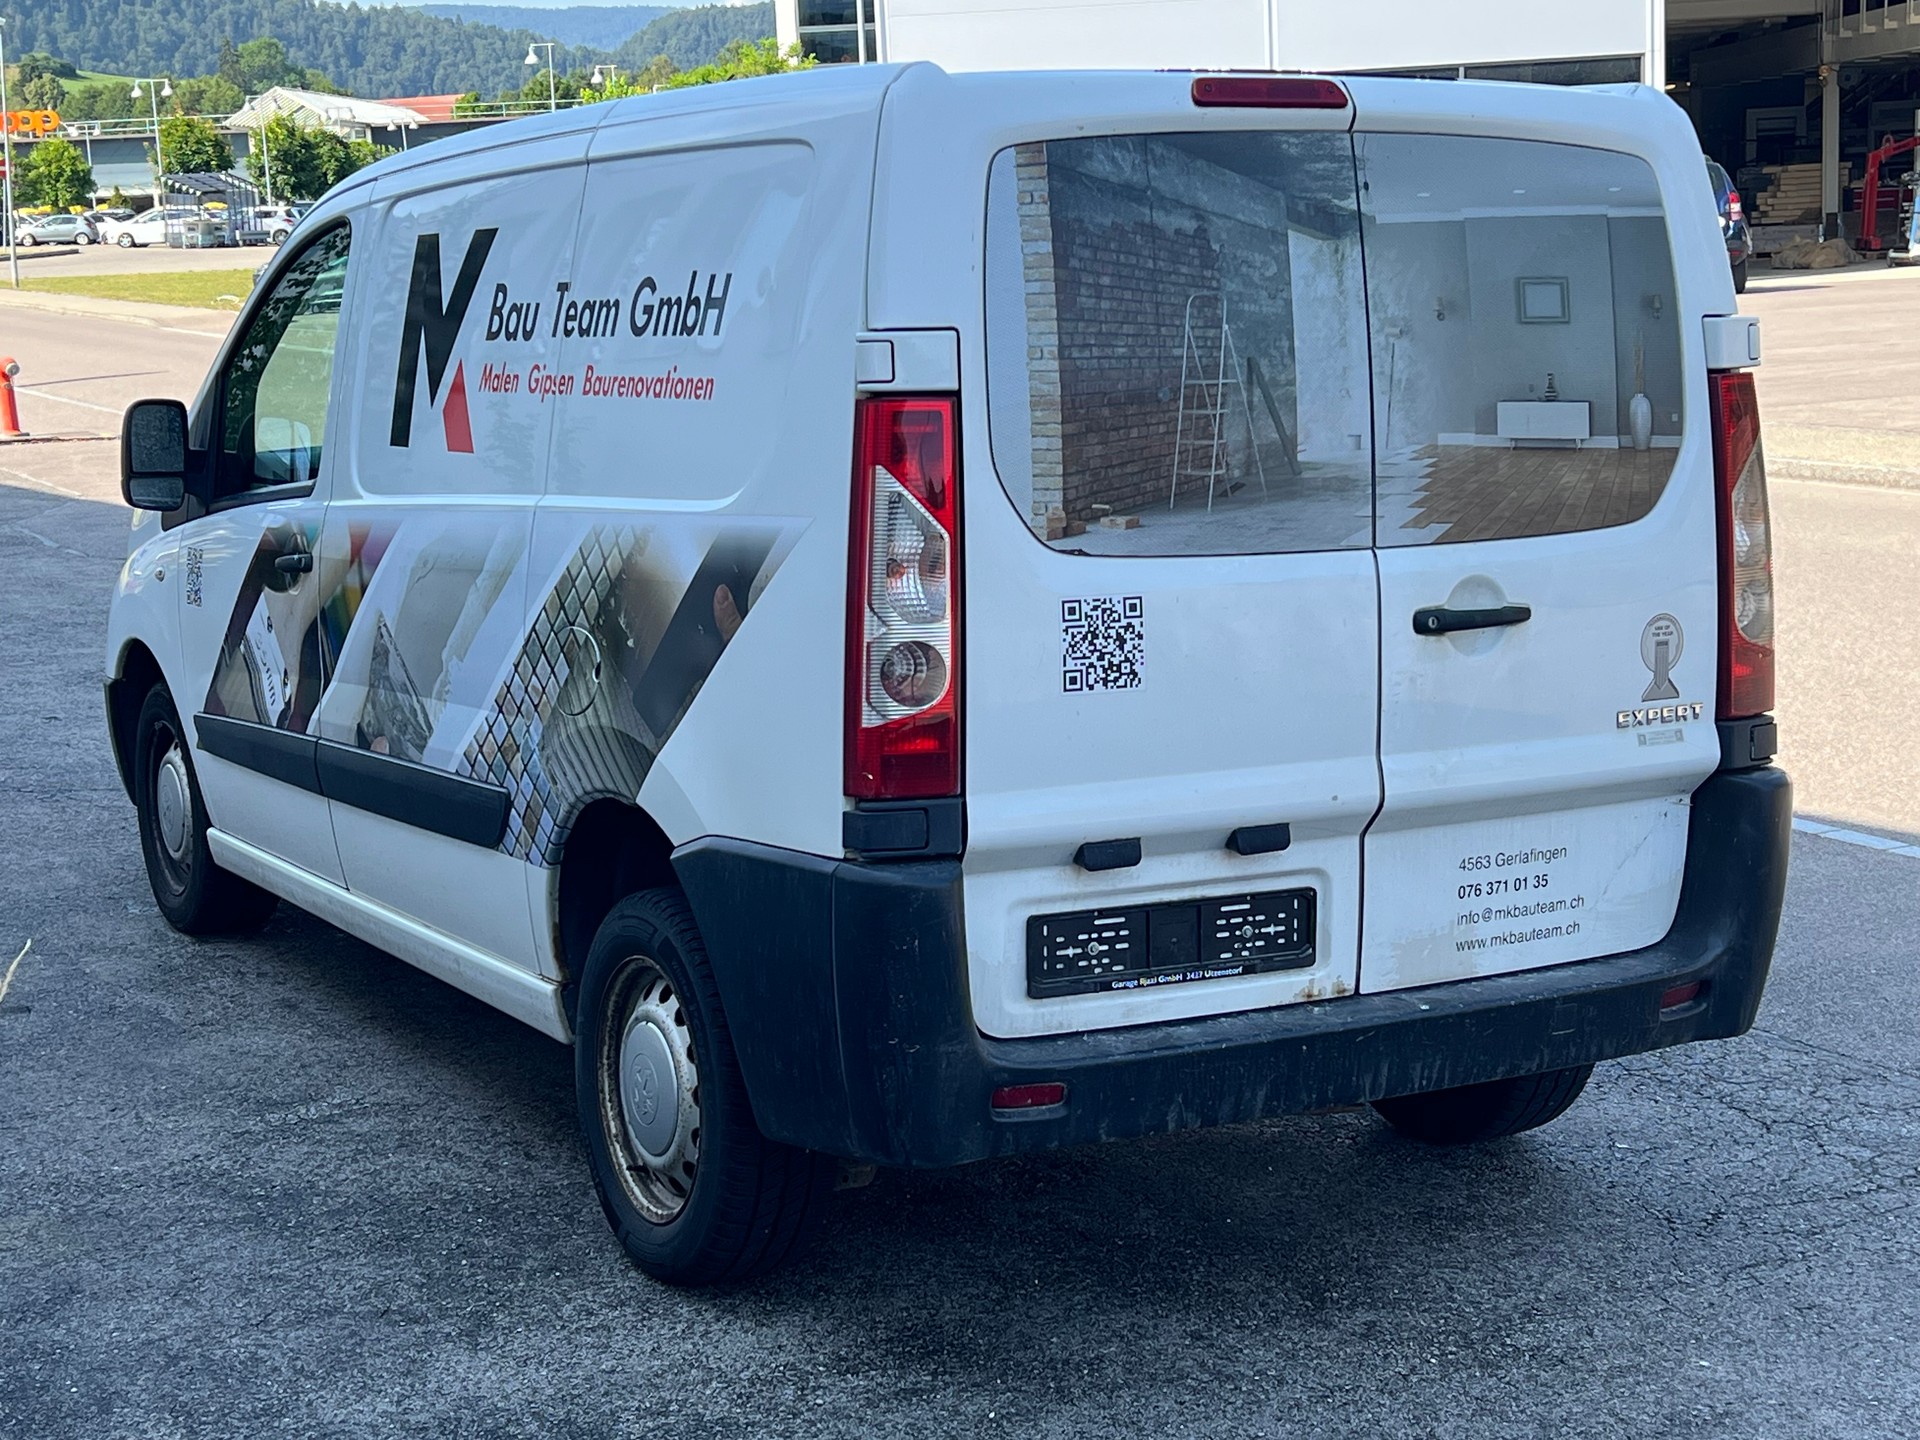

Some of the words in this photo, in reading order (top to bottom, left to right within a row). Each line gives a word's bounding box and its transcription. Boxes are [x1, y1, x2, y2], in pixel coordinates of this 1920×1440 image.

[485, 282, 541, 342] Bau
[551, 281, 620, 338] Team
[629, 270, 733, 338] GmbH
[478, 362, 520, 394] Malen
[527, 363, 575, 403] Gipsen
[582, 364, 715, 401] Baurenovationen
[1616, 702, 1704, 729] EXPERT
[1458, 854, 1491, 872] 4563
[1495, 847, 1567, 868] Gerlafingen
[1457, 883, 1482, 900] 076
[1486, 879, 1508, 896] 371
[1513, 876, 1528, 892] 01
[1532, 873, 1549, 889] 35
[1456, 894, 1585, 926] info@mkbauteam.ch
[1455, 920, 1580, 952] www.mkbauteam.ch
[1111, 979, 1139, 989] Garage
[1158, 973, 1183, 983] GmbH
